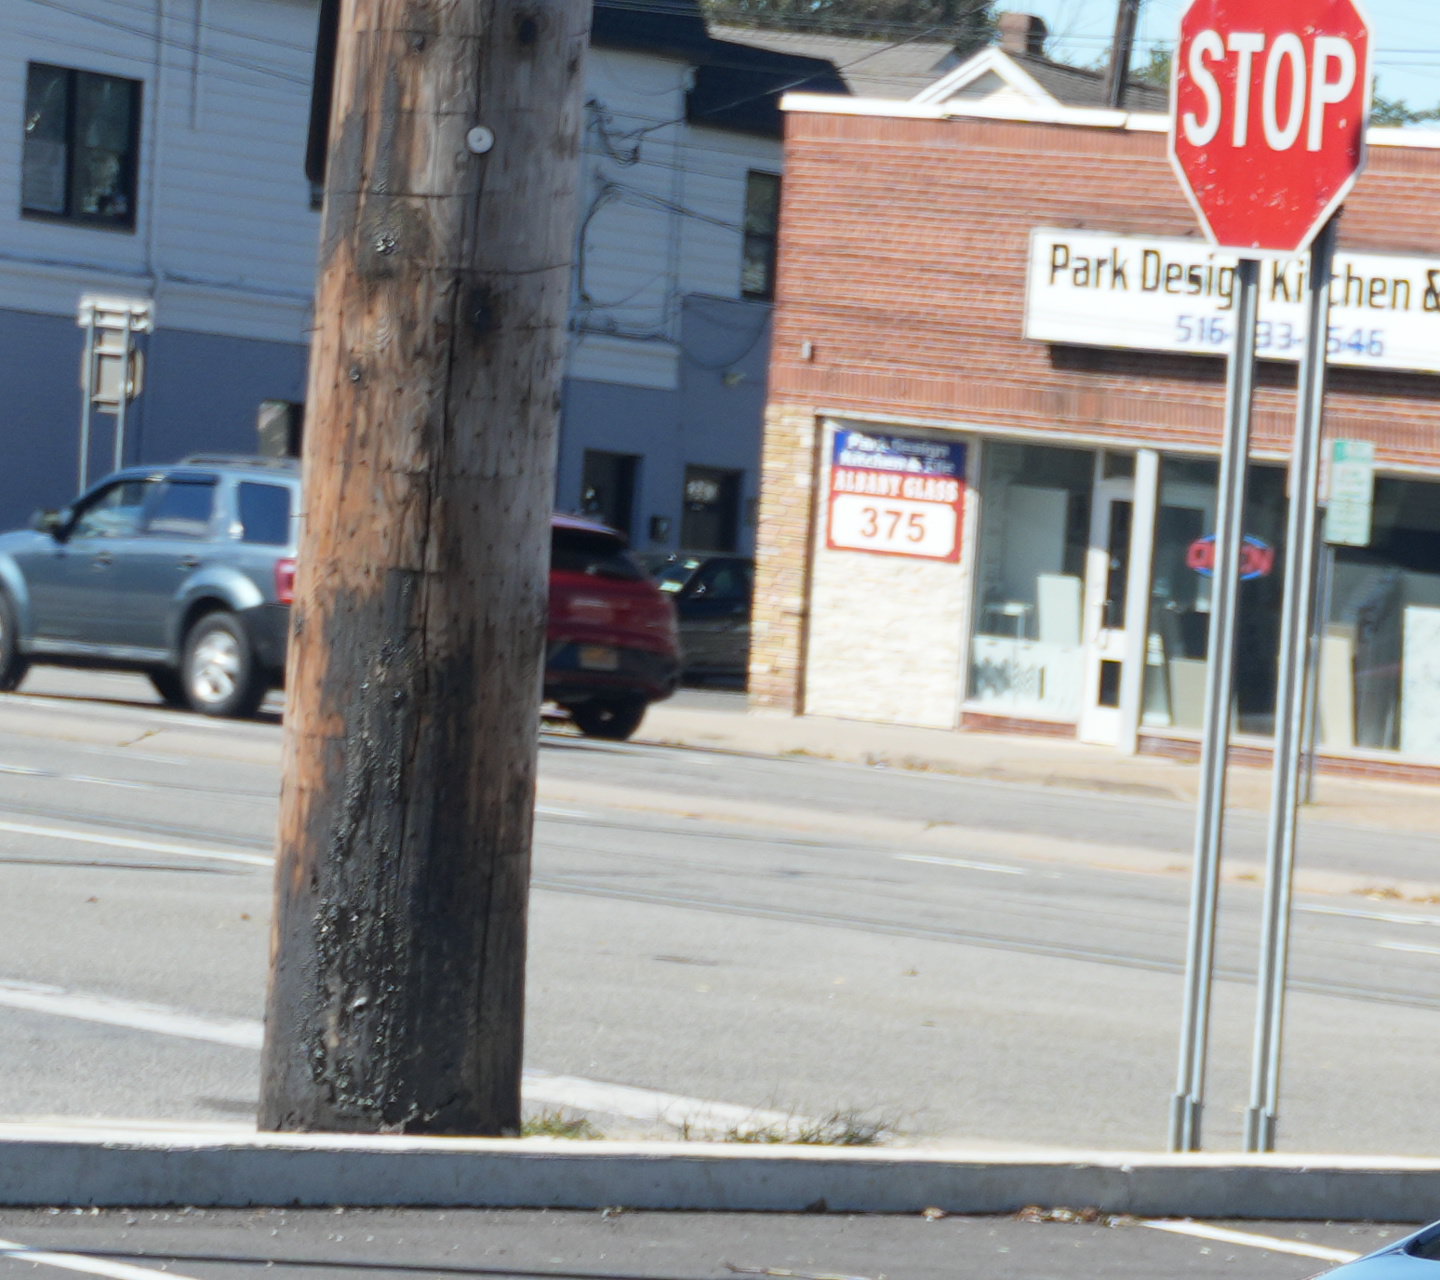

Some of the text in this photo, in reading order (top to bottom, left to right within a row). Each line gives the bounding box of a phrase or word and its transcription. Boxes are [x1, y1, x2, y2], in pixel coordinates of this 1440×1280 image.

[1183, 29, 1356, 152] STOP
[1049, 244, 1128, 291] Park
[1142, 249, 1235, 310] Desig
[835, 469, 959, 503] ALBANY GLASS
[860, 507, 926, 543] 375
